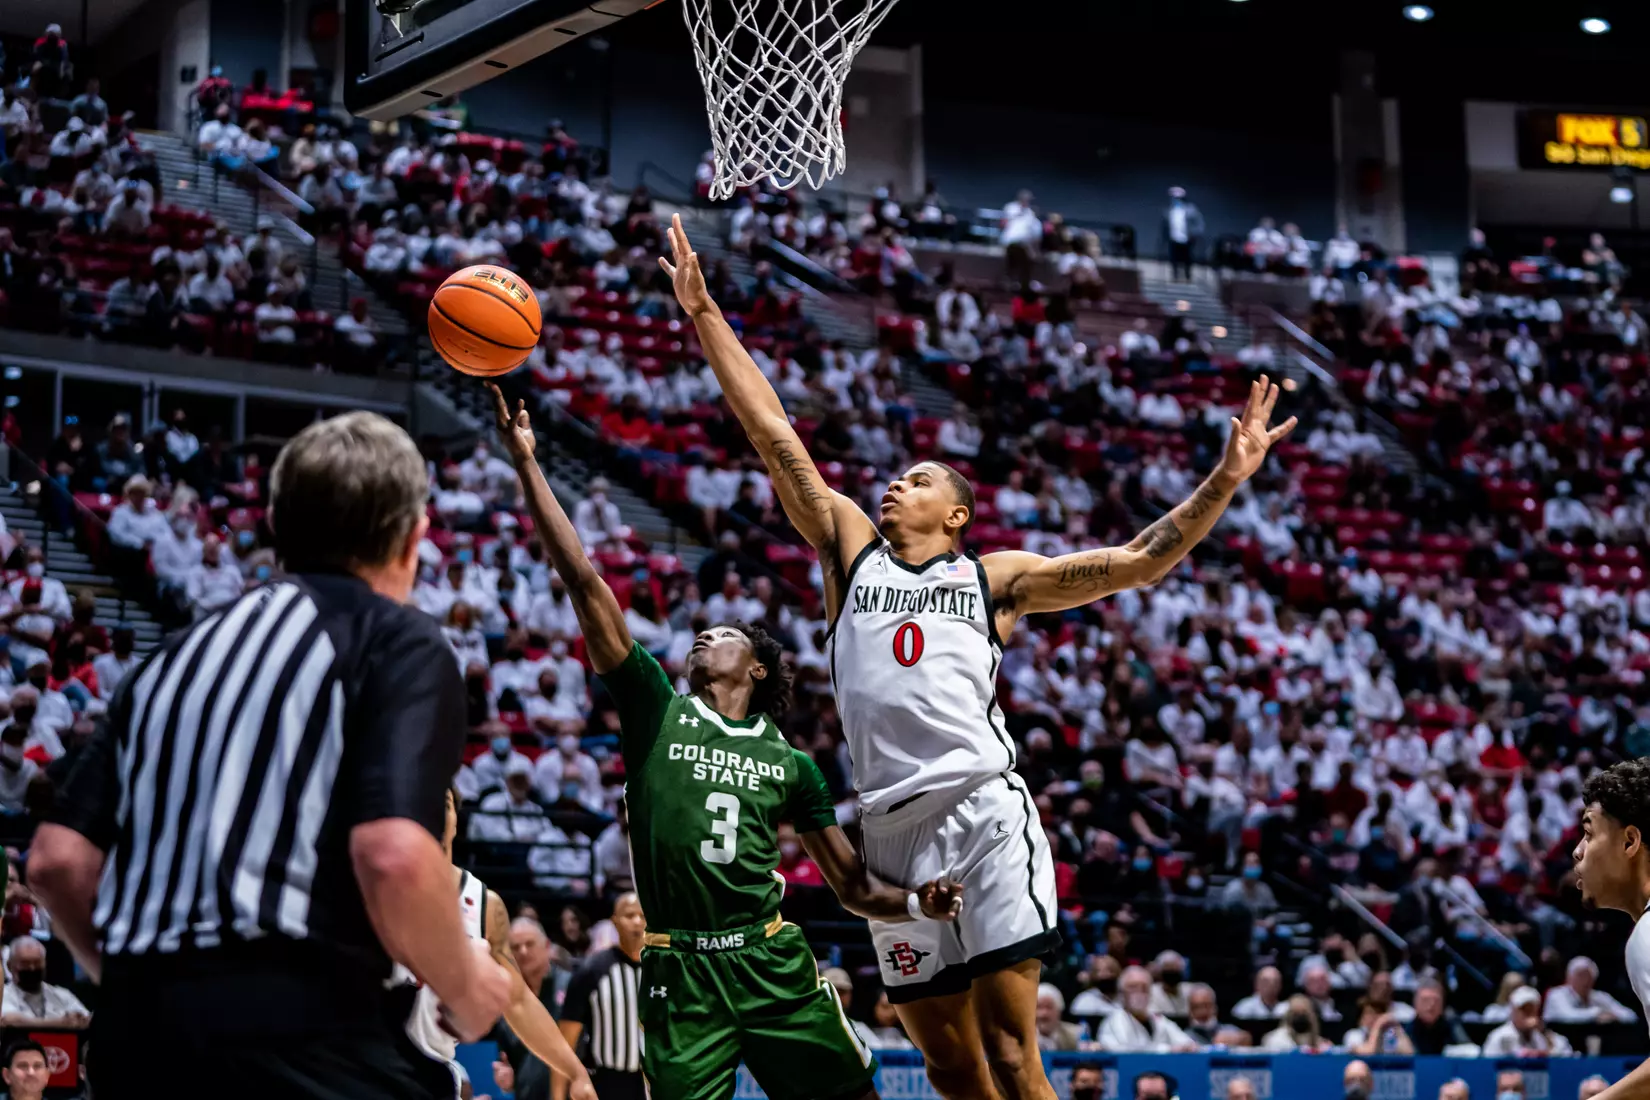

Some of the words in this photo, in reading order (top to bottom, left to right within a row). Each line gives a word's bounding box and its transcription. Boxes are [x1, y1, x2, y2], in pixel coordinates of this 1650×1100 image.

[1559, 116, 1617, 145] FOX
[1055, 552, 1115, 586] Finest
[853, 585, 882, 614] SAN
[881, 586, 929, 614] DIEGO
[928, 586, 977, 621] STATE
[892, 621, 925, 668] 0
[668, 743, 785, 781] COLORADO
[693, 763, 761, 792] STATE
[700, 791, 741, 865] 3
[696, 933, 745, 950] RAMS
